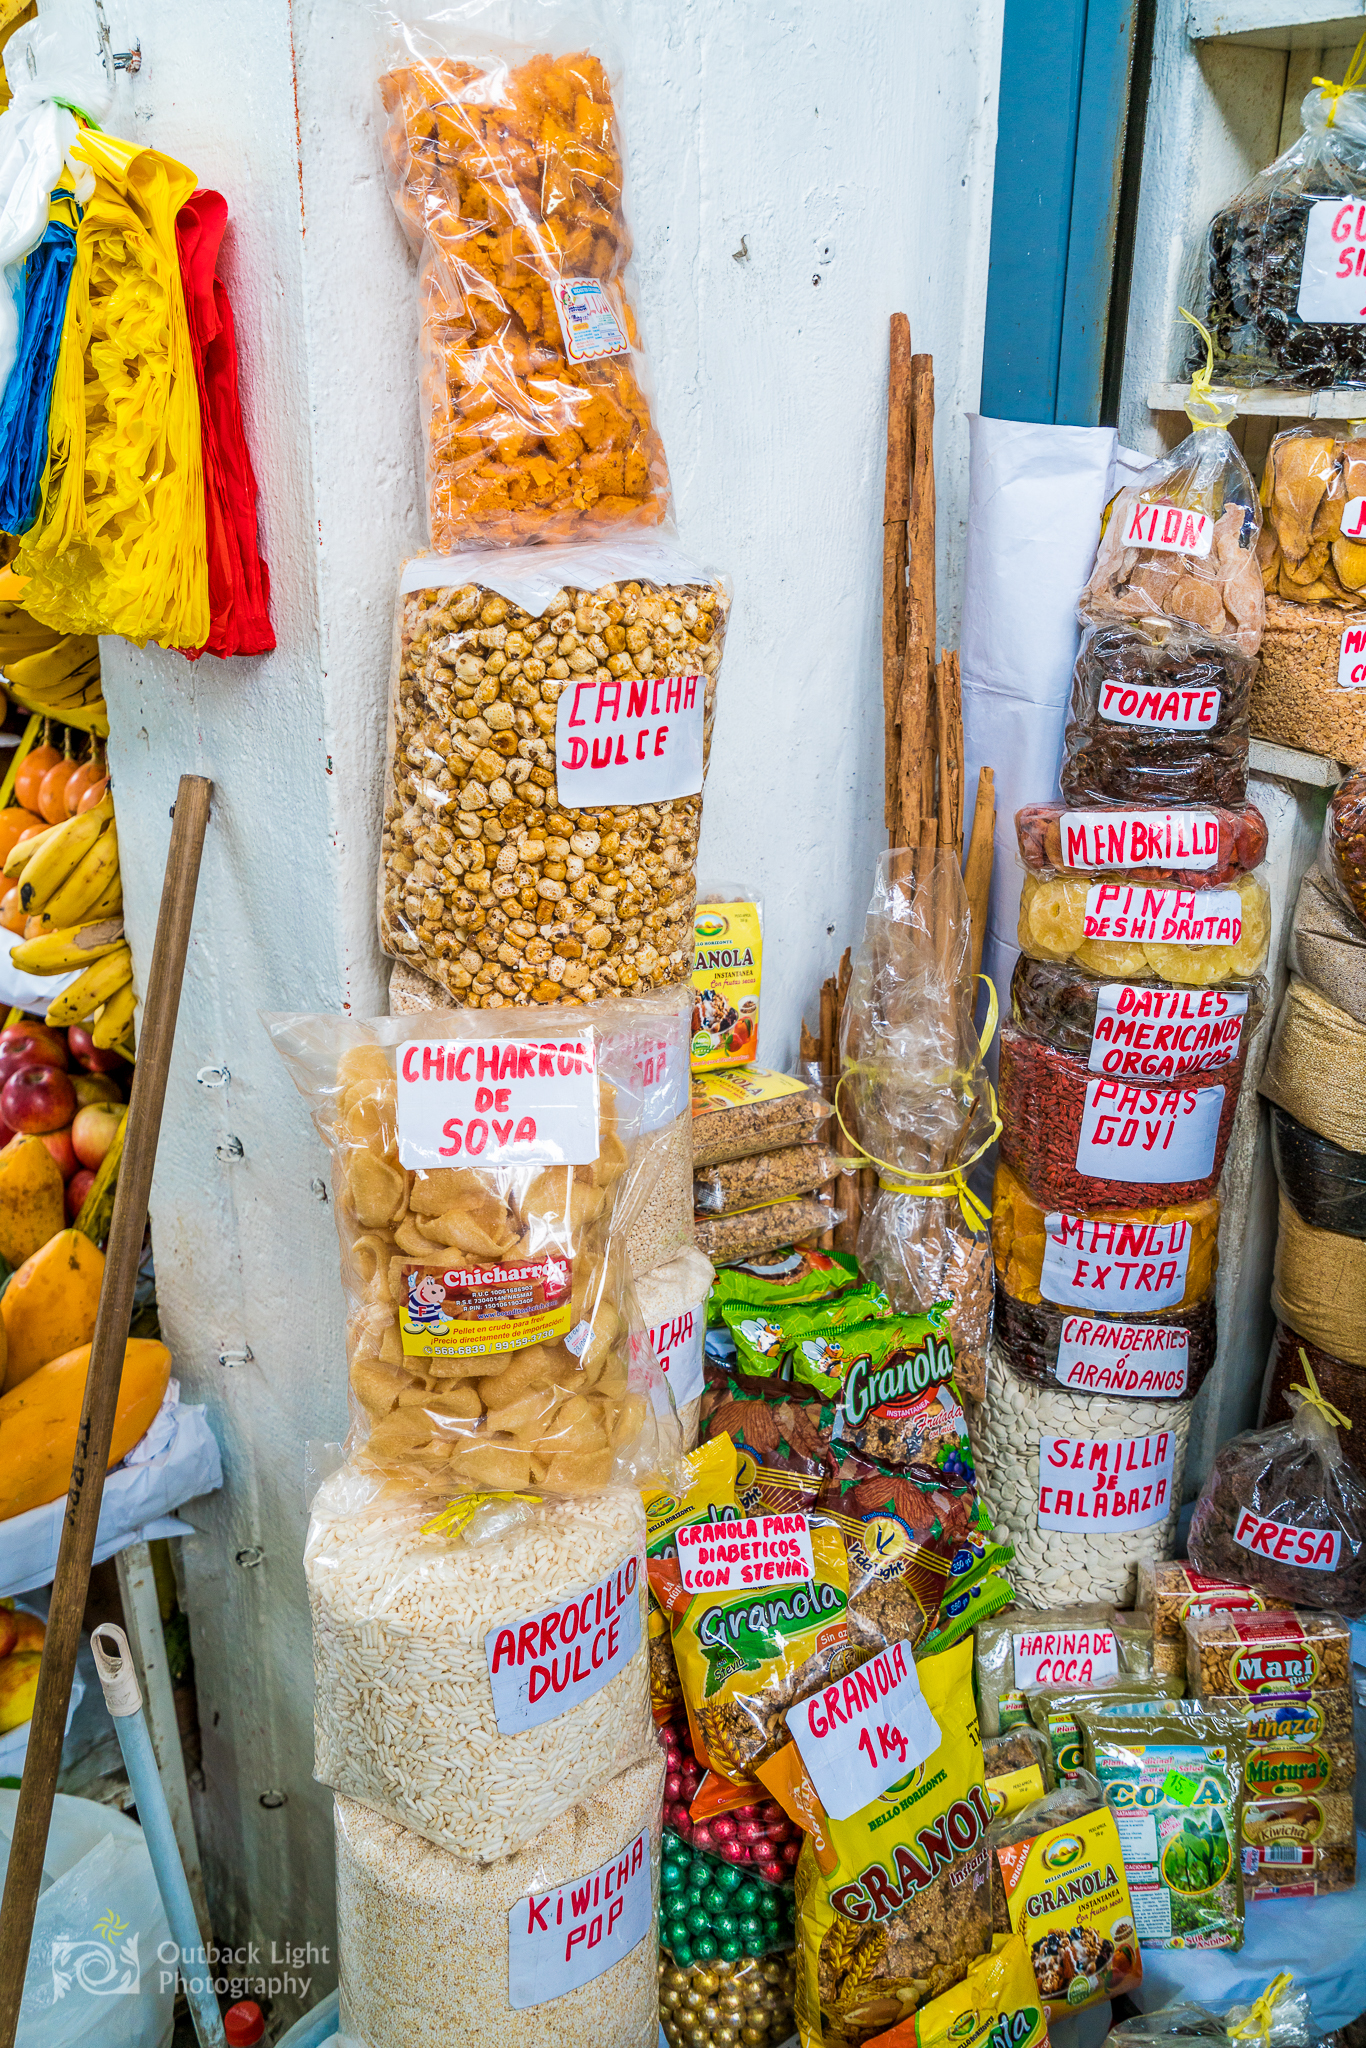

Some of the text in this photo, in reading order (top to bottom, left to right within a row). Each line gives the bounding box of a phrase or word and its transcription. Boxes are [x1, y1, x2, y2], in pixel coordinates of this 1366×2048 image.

[1335, 246, 1366, 279] SI
[1129, 503, 1206, 549] KION
[568, 675, 699, 728] CANCHA
[1103, 683, 1217, 722] TOMATE
[562, 725, 669, 770] DULCE
[694, 947, 754, 970] ANOLA
[714, 970, 754, 979] INSTANTANEA
[1116, 987, 1229, 1019] DATILES
[1095, 1014, 1243, 1052] AMERICANOS
[1102, 1044, 1233, 1077] ORGANICOS
[474, 1086, 512, 1113] DE
[1091, 1079, 1199, 1116] PASAS
[438, 1116, 537, 1156] SOYA
[1051, 1214, 1187, 1257] MANGO
[1071, 1259, 1178, 1292] EXTRA
[418, 1306, 427, 1317] F
[452, 1325, 476, 1335] Pellet
[488, 1323, 511, 1333] crudo
[512, 1320, 530, 1330] para
[459, 1332, 511, 1344] directamente
[511, 1330, 521, 1339] de
[1063, 1318, 1191, 1352] CRANBERRIES
[434, 1344, 486, 1356] 568-6839
[495, 1329, 555, 1351] 99159-3730
[844, 1336, 954, 1425] Granola
[1067, 1361, 1185, 1391] ARANDANOS
[886, 1399, 930, 1418] INSTANTANEA
[913, 1404, 964, 1436] Frutada
[1047, 1432, 1169, 1474] SEMILLA
[1092, 1472, 1119, 1492] DE
[740, 1486, 762, 1510] ght
[1039, 1478, 1167, 1518] CALABAZA
[648, 1505, 696, 1534] BELLO HORIZONTE
[678, 1518, 758, 1547] GRANOLA
[763, 1513, 807, 1538] PARA
[698, 1537, 801, 1565] DIABETICOS
[1236, 1512, 1335, 1565] FRESA
[848, 1541, 873, 1573] Vida
[663, 1581, 675, 1592] LA
[665, 1583, 683, 1611] ORIGIN
[491, 1556, 638, 1674] ARROCILLO
[698, 1579, 843, 1647] Granola
[820, 1630, 848, 1645] Sin az
[528, 1614, 621, 1704] DULCE
[714, 1658, 745, 1682] Stevia
[1036, 1658, 1093, 1682] COCA
[1237, 1653, 1313, 1681] Maní
[808, 1643, 908, 1738] GRANOLA
[1056, 1725, 1081, 1734] Plant
[1246, 1717, 1319, 1739] Linaza
[858, 1727, 878, 1768] 1
[1134, 1756, 1174, 1765] dicinal
[1178, 1764, 1204, 1772] Salud
[1248, 1757, 1329, 1784] Mistura's
[868, 1768, 948, 1832] BELLO HORIZONTE
[1103, 1777, 1228, 1810] COA
[1158, 1815, 1177, 1832] 100%
[1160, 1821, 1182, 1838] NATURAL
[1261, 1823, 1306, 1841] Kiwicha
[829, 1784, 995, 1923] GRANOL
[948, 1847, 990, 1888] Instant
[1009, 1854, 1018, 1867] LA
[1009, 1843, 1030, 1888] ORIGINAL
[1044, 1861, 1092, 1885] BELLO HORIZONTE
[1026, 1864, 1119, 1918] GRANOLA
[1078, 1888, 1120, 1912] INSTANTANEA
[1090, 1904, 1109, 1922] frutas
[1109, 1896, 1124, 1908] secas
[565, 1895, 623, 1962] POP
[1185, 1934, 1204, 1944] SUR
[1196, 1935, 1232, 1949] ANDINA
[957, 2034, 972, 2048] ELLO
